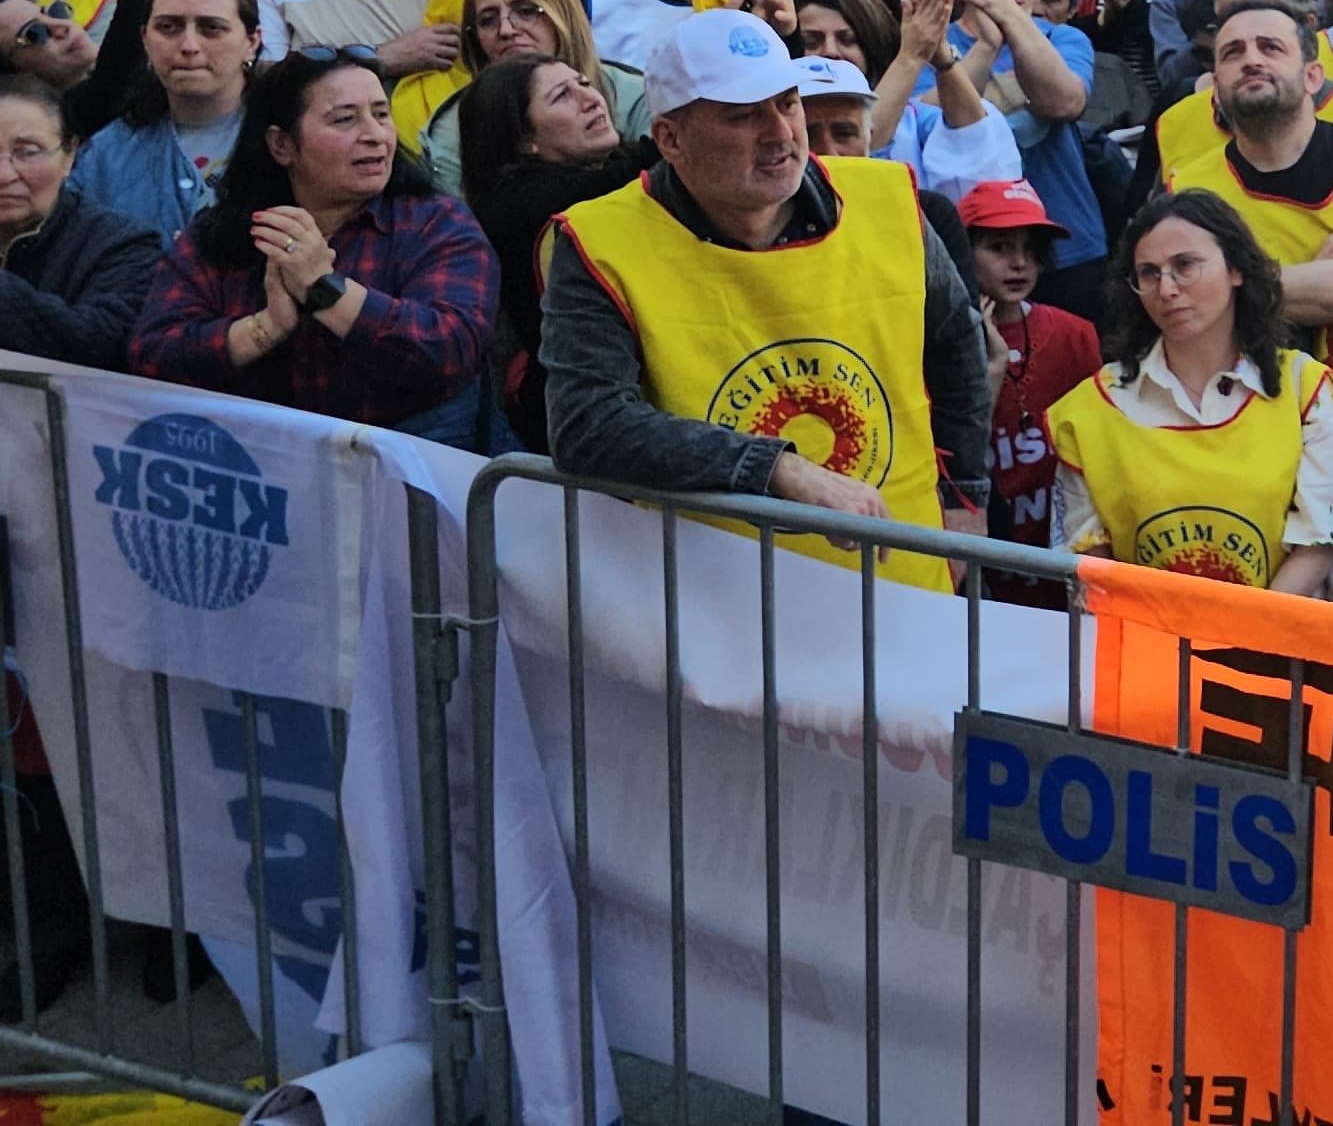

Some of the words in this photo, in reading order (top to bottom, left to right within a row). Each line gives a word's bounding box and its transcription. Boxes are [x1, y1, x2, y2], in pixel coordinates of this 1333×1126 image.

[717, 355, 820, 430] EĞİTİM
[832, 362, 877, 409] SEN
[1138, 520, 1213, 565] ĞİTİM
[963, 734, 1300, 908] POLİS
